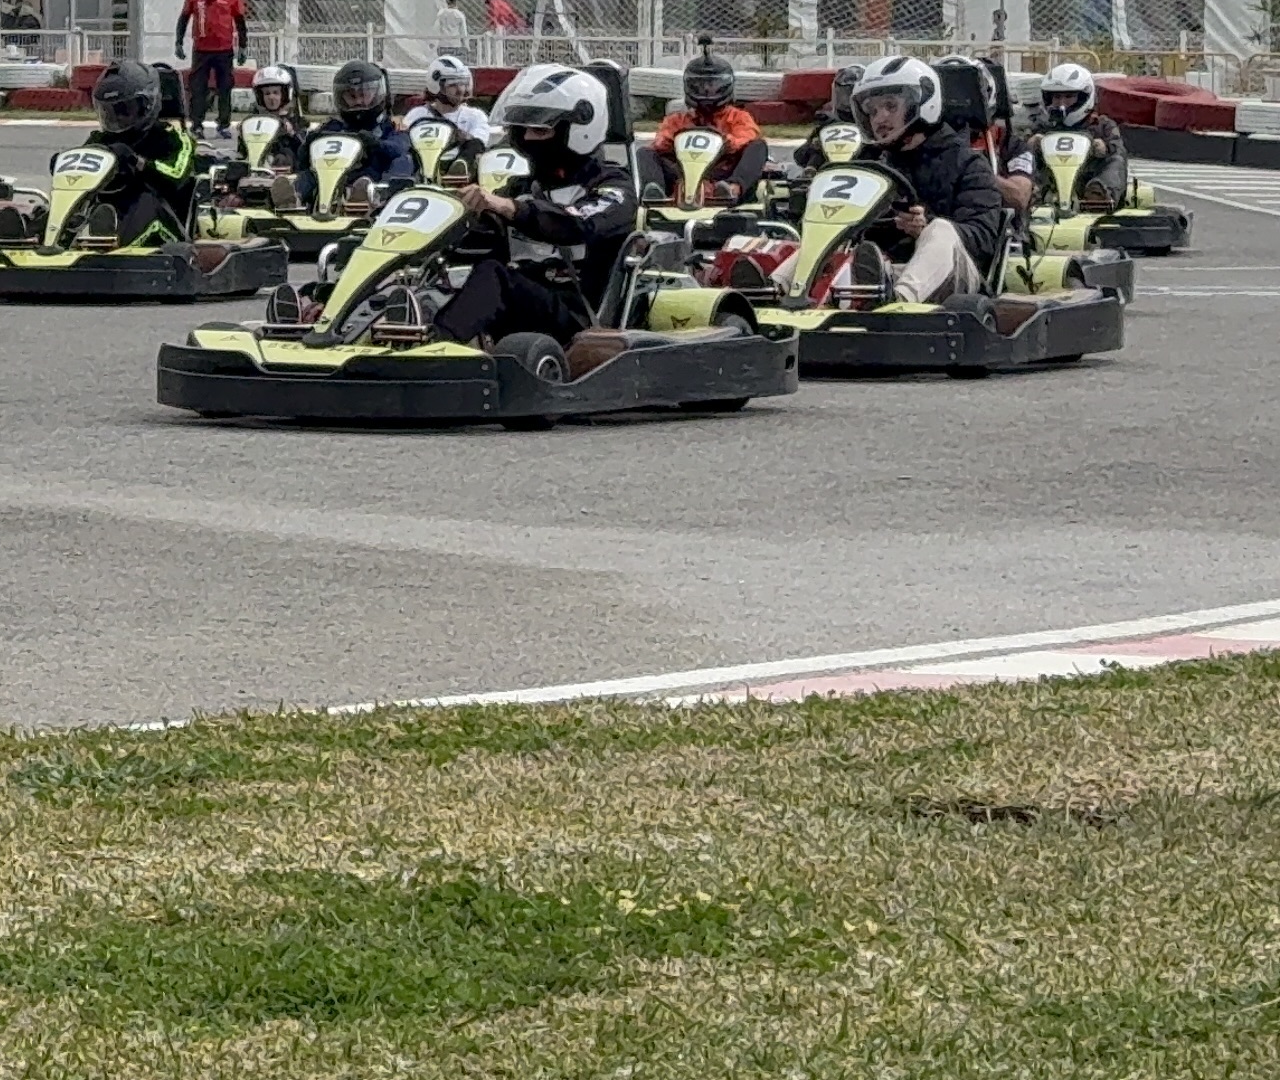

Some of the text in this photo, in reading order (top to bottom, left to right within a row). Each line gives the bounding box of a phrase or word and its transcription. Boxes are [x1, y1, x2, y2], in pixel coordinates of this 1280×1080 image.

[255, 120, 262, 131] 1
[419, 126, 440, 139] 21
[684, 134, 710, 150] 10
[824, 128, 857, 143] 22
[323, 140, 343, 154] 3
[1055, 137, 1075, 152] 8
[56, 152, 105, 173] 25
[495, 153, 516, 170] 7
[822, 175, 858, 200] 2
[389, 197, 429, 223] 9
